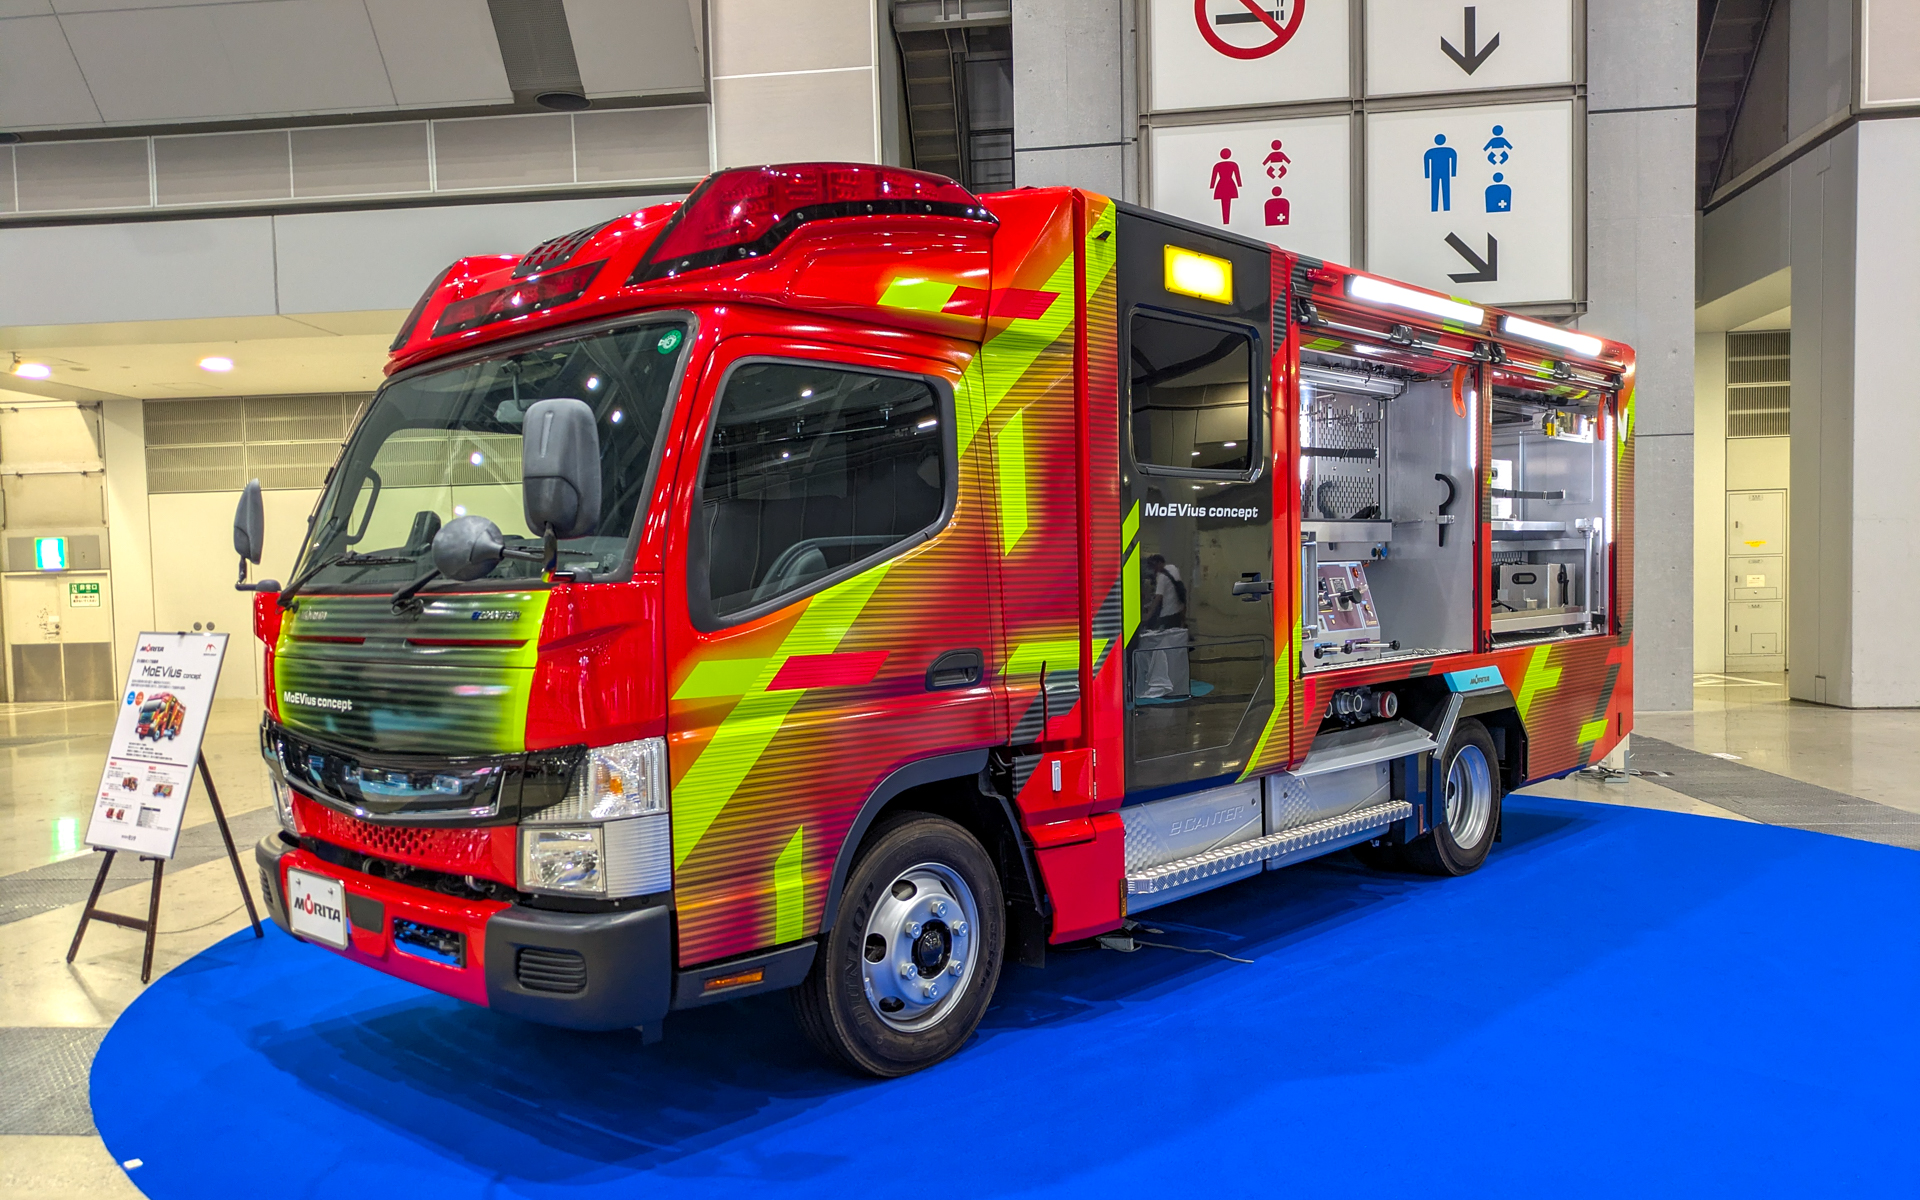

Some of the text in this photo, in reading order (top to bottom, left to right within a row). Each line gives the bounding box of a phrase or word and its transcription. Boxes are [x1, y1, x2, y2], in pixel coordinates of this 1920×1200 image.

[1144, 502, 1259, 521] MoEVius concept
[141, 665, 183, 679] MoEVius
[283, 690, 353, 713] MoEVius concept
[293, 893, 342, 923] MORITA
